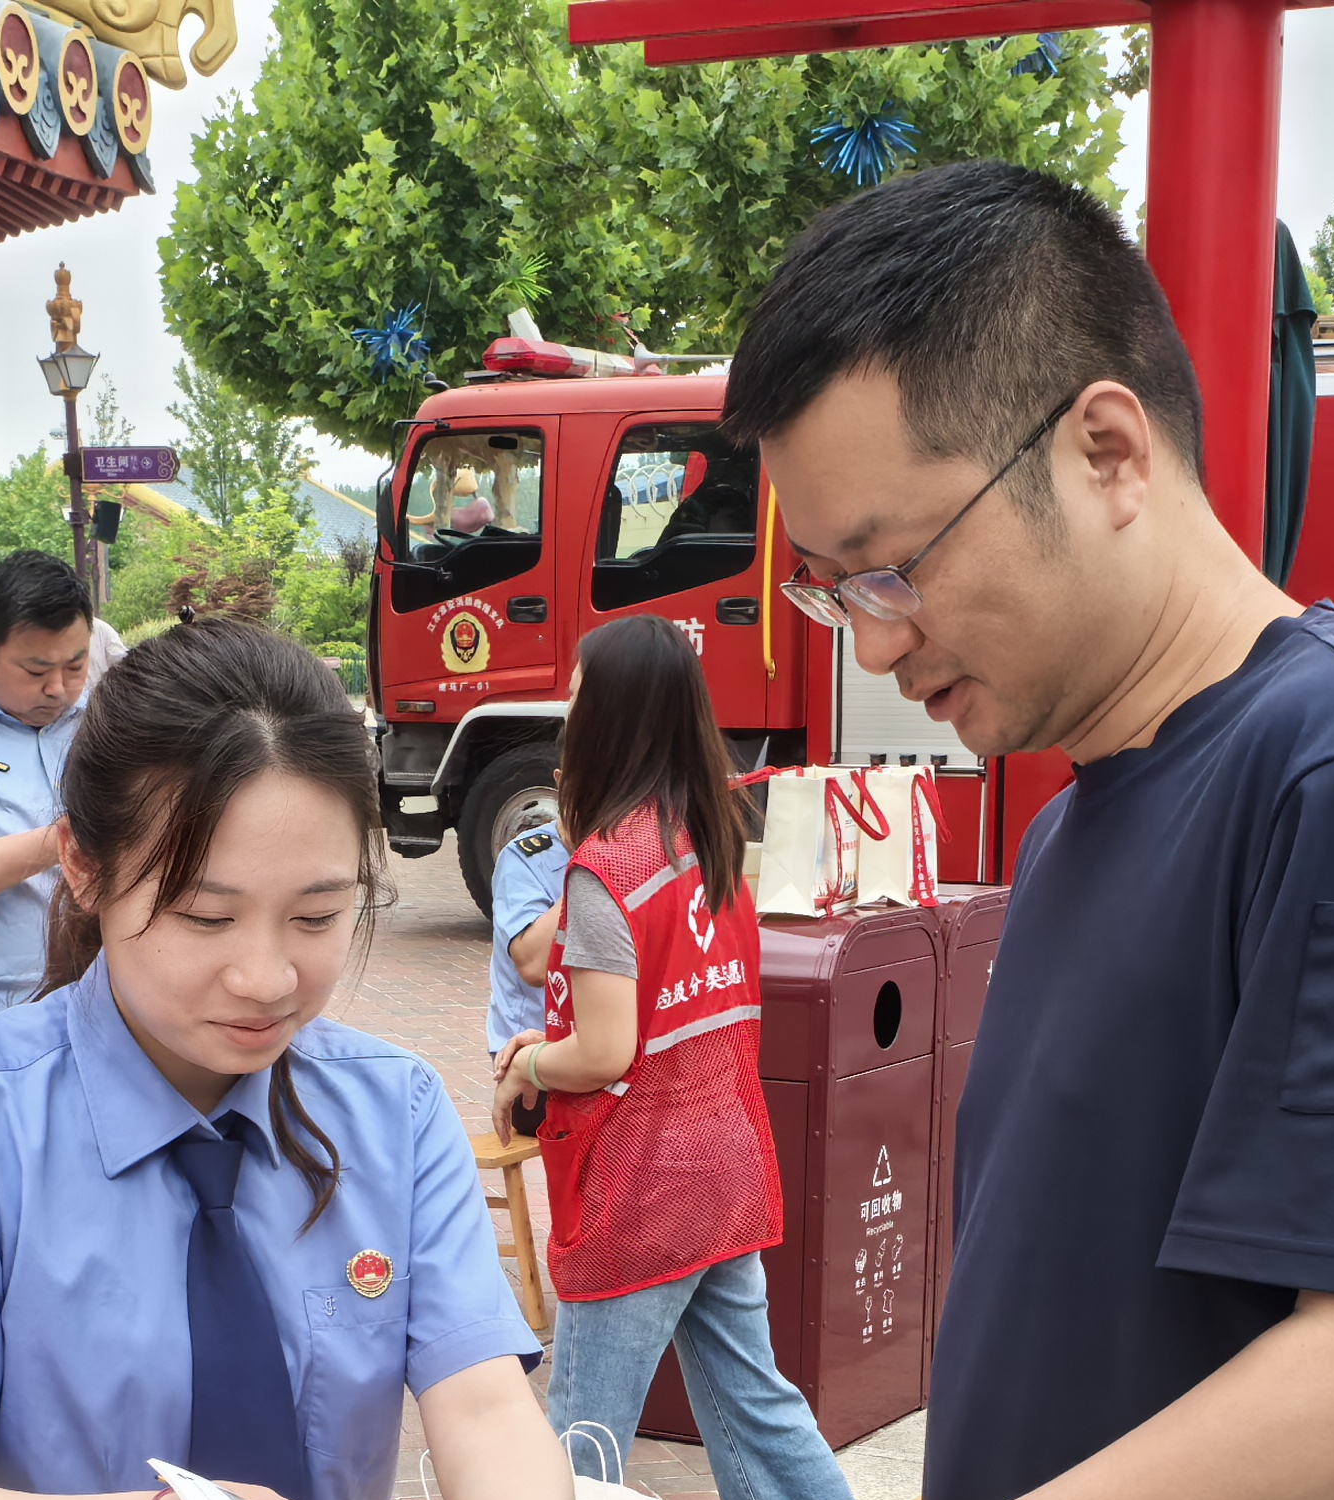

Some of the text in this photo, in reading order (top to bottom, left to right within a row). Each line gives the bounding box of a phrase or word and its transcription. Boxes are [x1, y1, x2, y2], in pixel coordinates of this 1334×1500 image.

[95, 455, 129, 468] 卫生间
[860, 1189, 903, 1223] 可回收物
